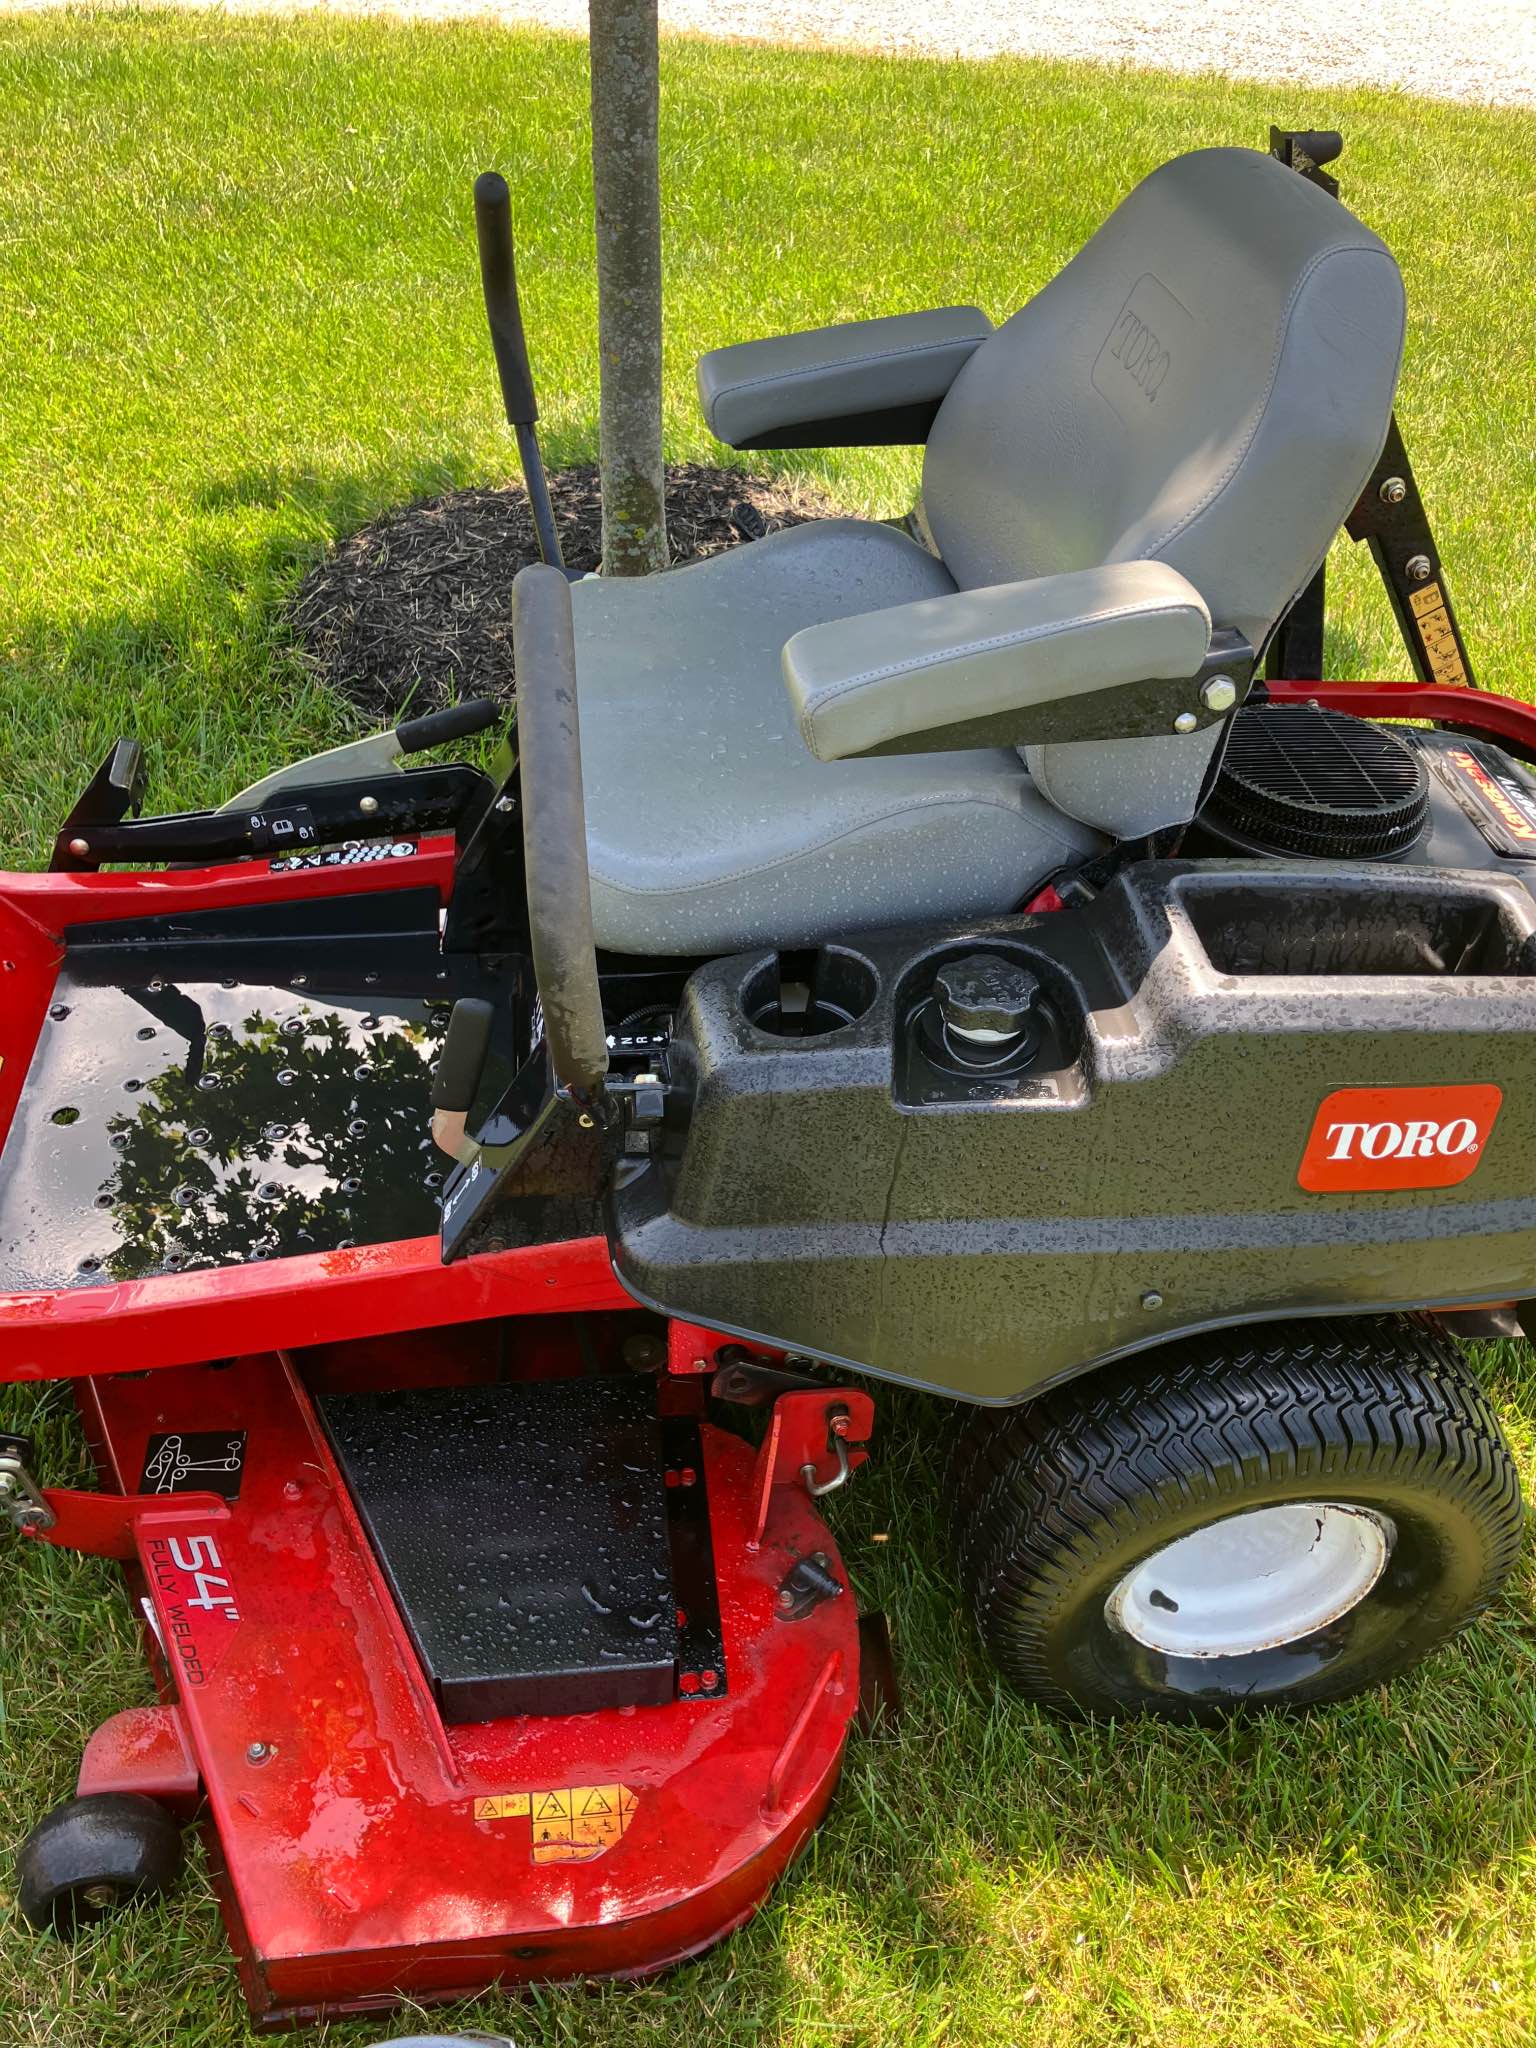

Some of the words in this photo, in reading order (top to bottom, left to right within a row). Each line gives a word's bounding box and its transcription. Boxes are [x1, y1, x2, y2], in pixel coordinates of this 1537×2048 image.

[1111, 310, 1170, 402] TORO
[1447, 751, 1536, 839] Kawasaki
[147, 1540, 179, 1595] FULLY
[167, 1604, 205, 1685] WELDED
